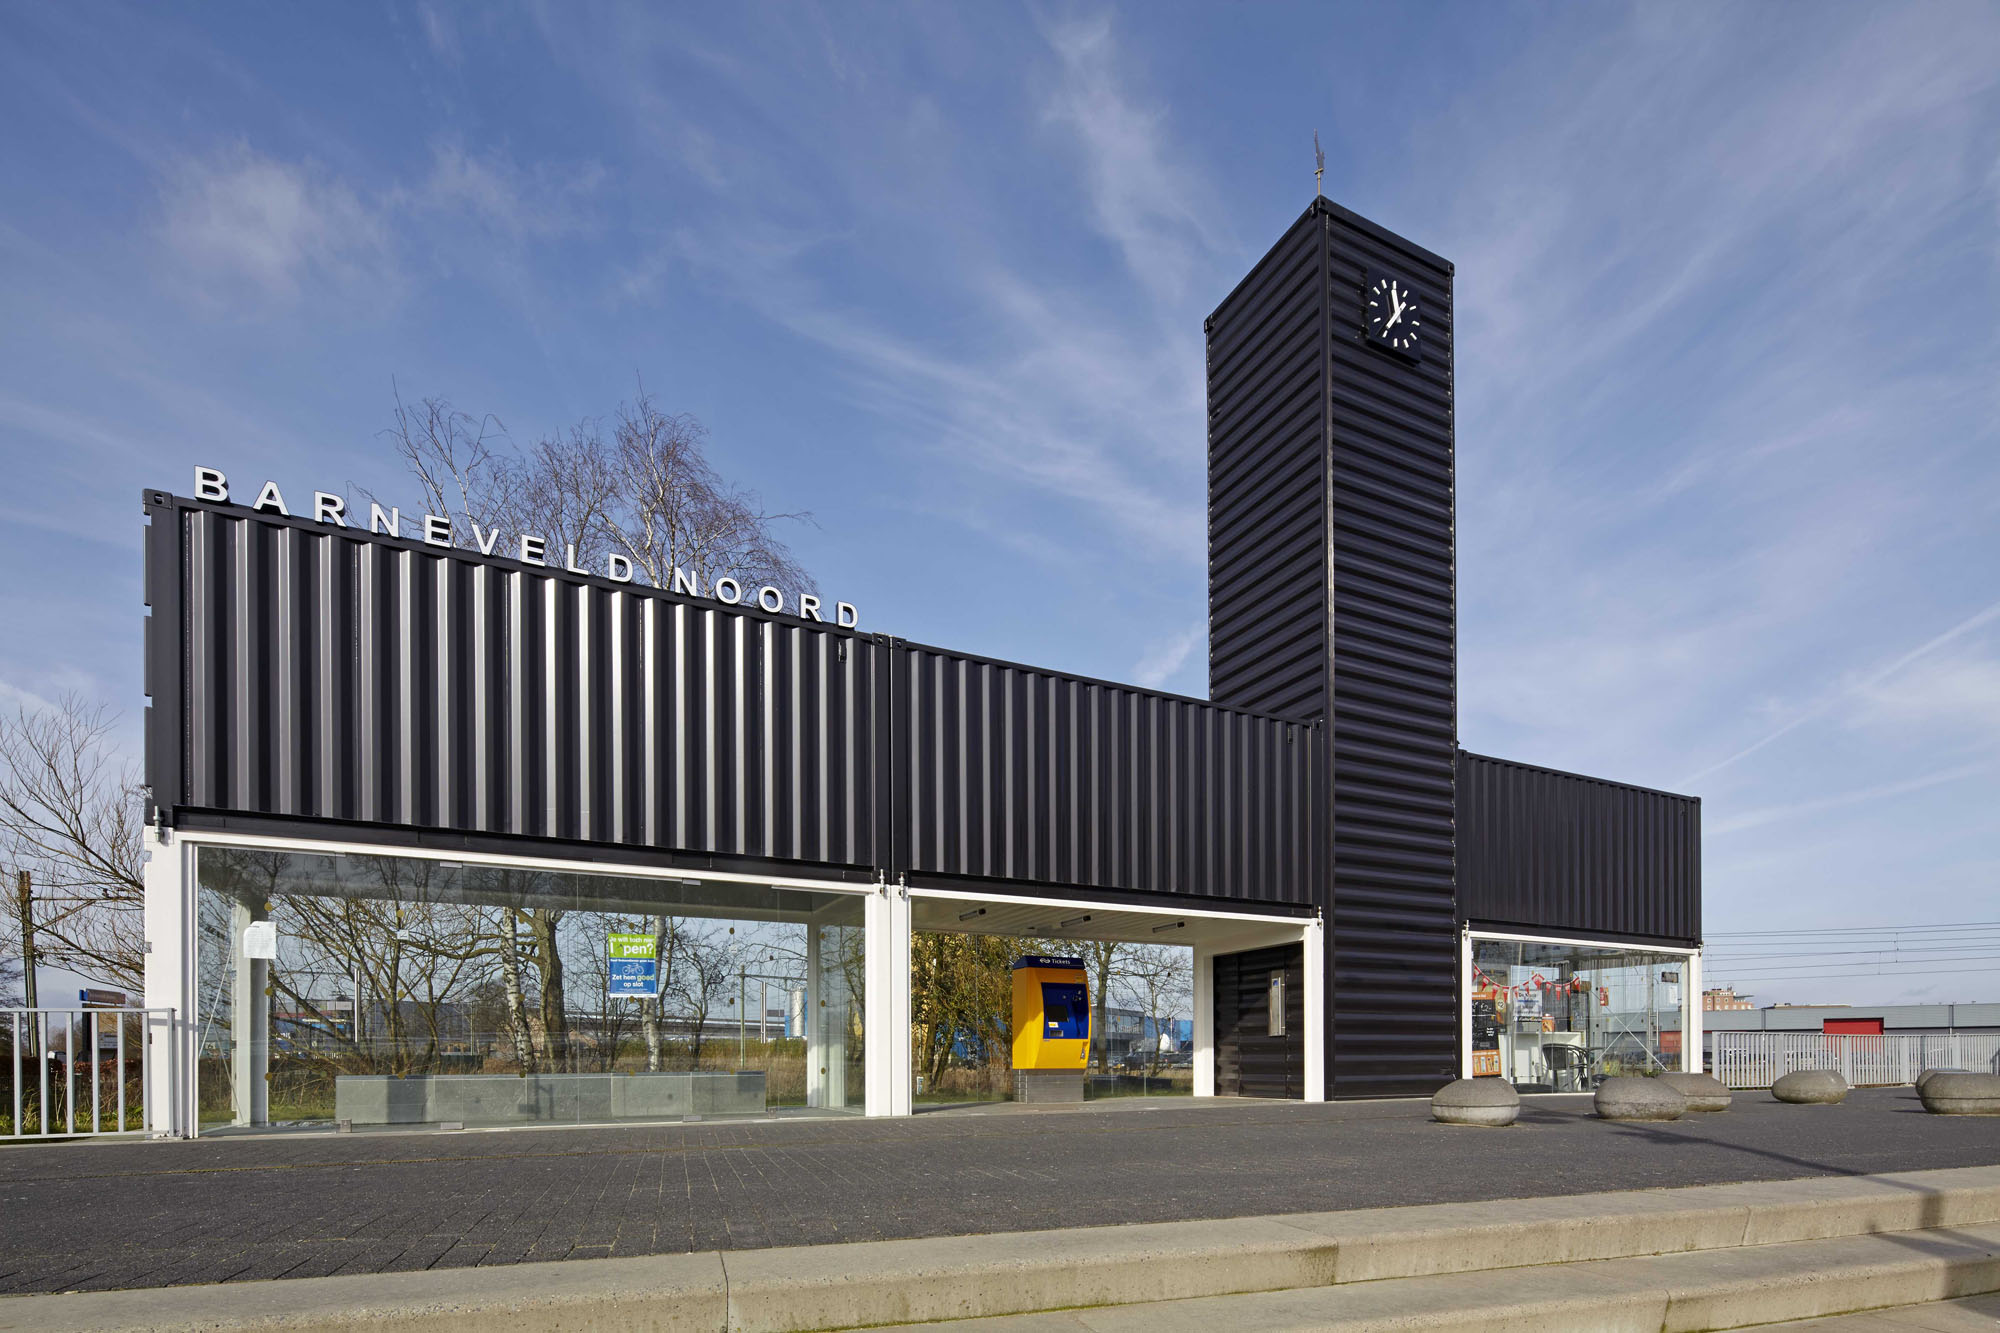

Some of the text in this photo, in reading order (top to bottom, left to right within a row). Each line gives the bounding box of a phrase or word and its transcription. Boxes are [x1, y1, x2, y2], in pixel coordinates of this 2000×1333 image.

[194, 465, 859, 629] BARNEVELD NOORD
[637, 974, 655, 982] goed
